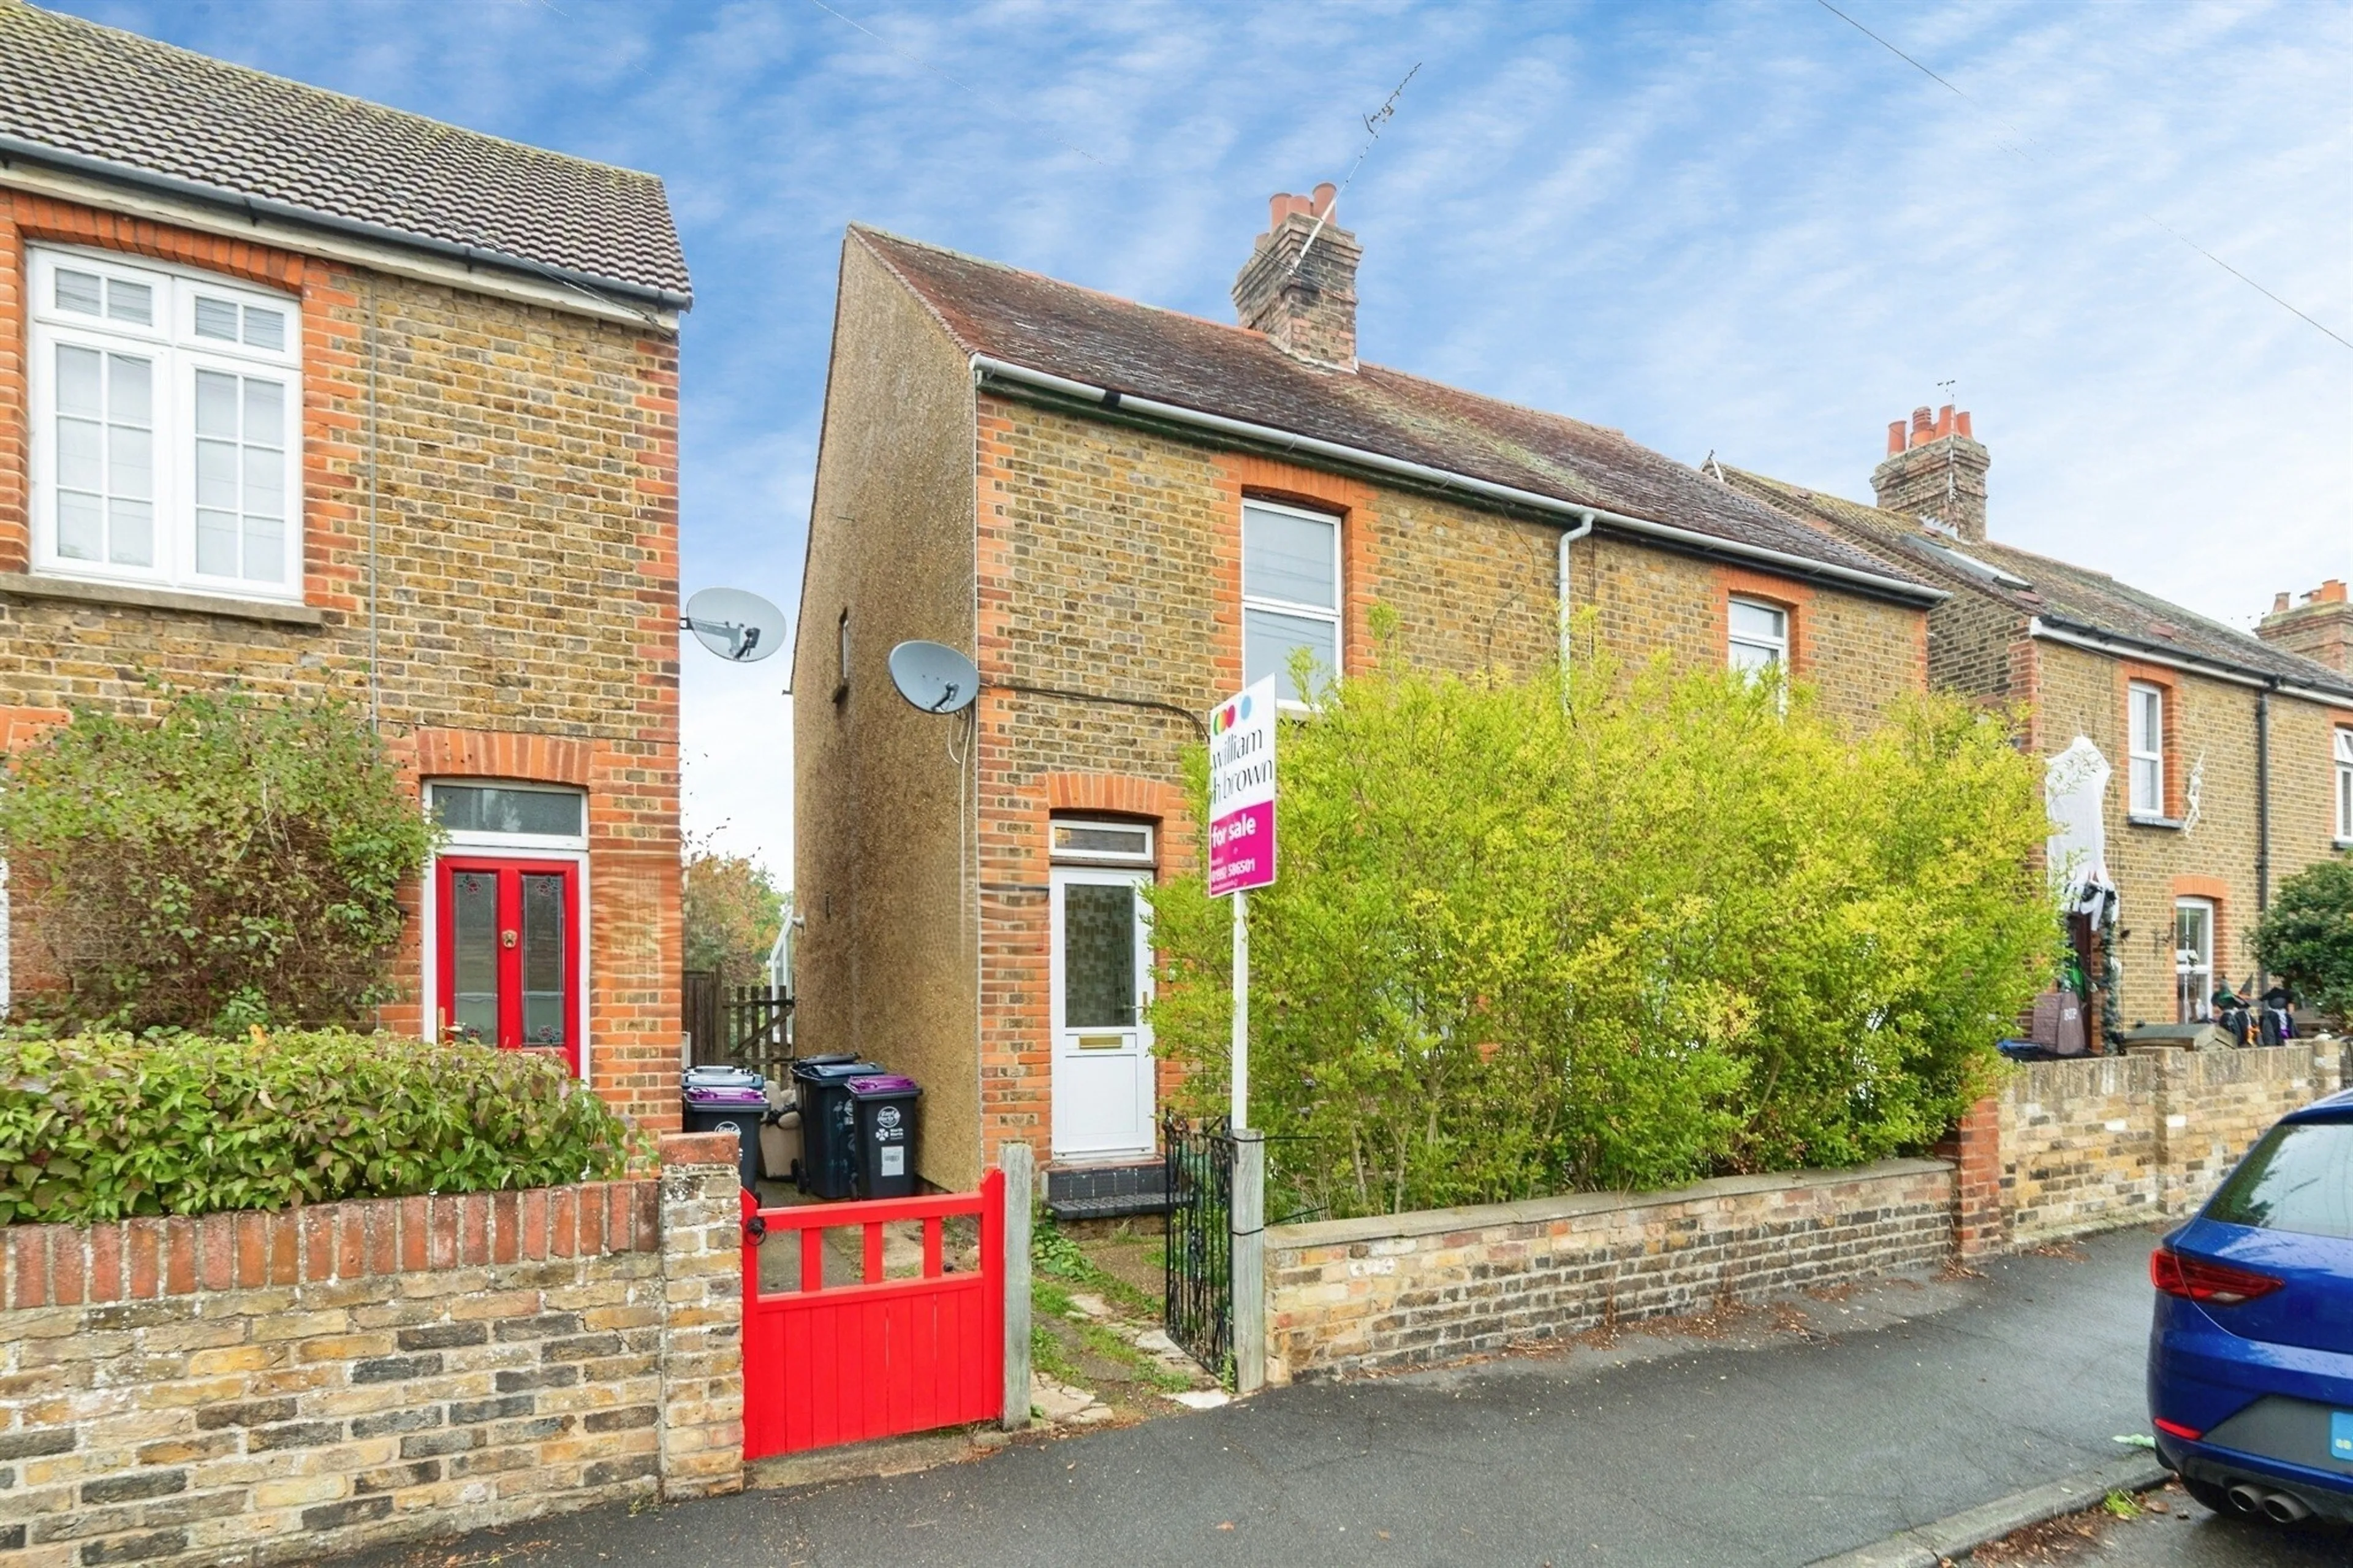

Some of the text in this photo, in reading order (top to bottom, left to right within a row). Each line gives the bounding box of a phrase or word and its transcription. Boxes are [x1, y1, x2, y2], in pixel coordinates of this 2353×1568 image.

[1213, 729, 1262, 770] william
[1223, 760, 1272, 798] brown
[1212, 812, 1256, 849] for sale
